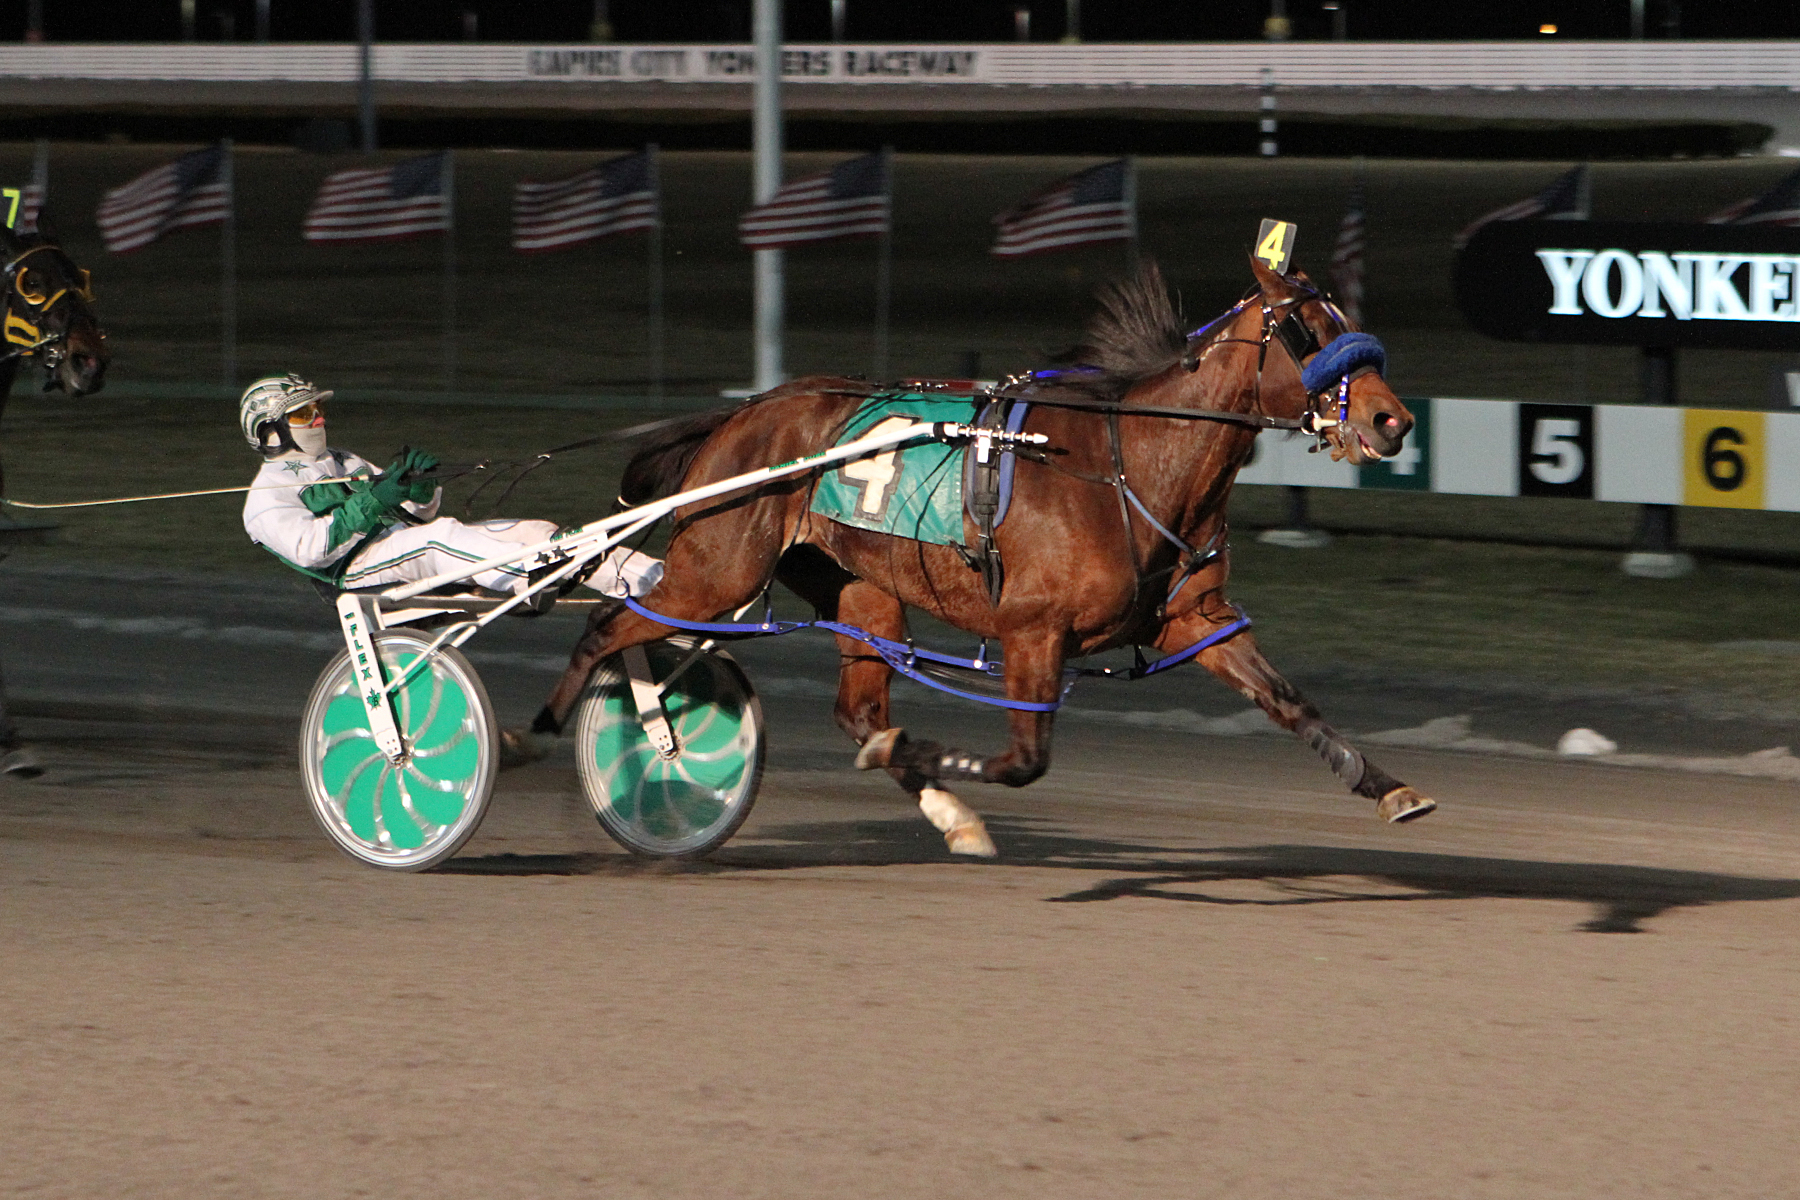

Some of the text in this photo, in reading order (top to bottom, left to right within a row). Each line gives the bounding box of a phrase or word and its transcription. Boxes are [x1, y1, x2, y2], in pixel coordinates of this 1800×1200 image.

[703, 51, 830, 76] YONERS
[844, 51, 977, 77] RACEWAY
[3, 188, 21, 229] 7
[1257, 221, 1288, 270] 4
[1536, 249, 1800, 323] YONKE
[840, 413, 917, 519] 4
[1528, 418, 1748, 492] 5 6
